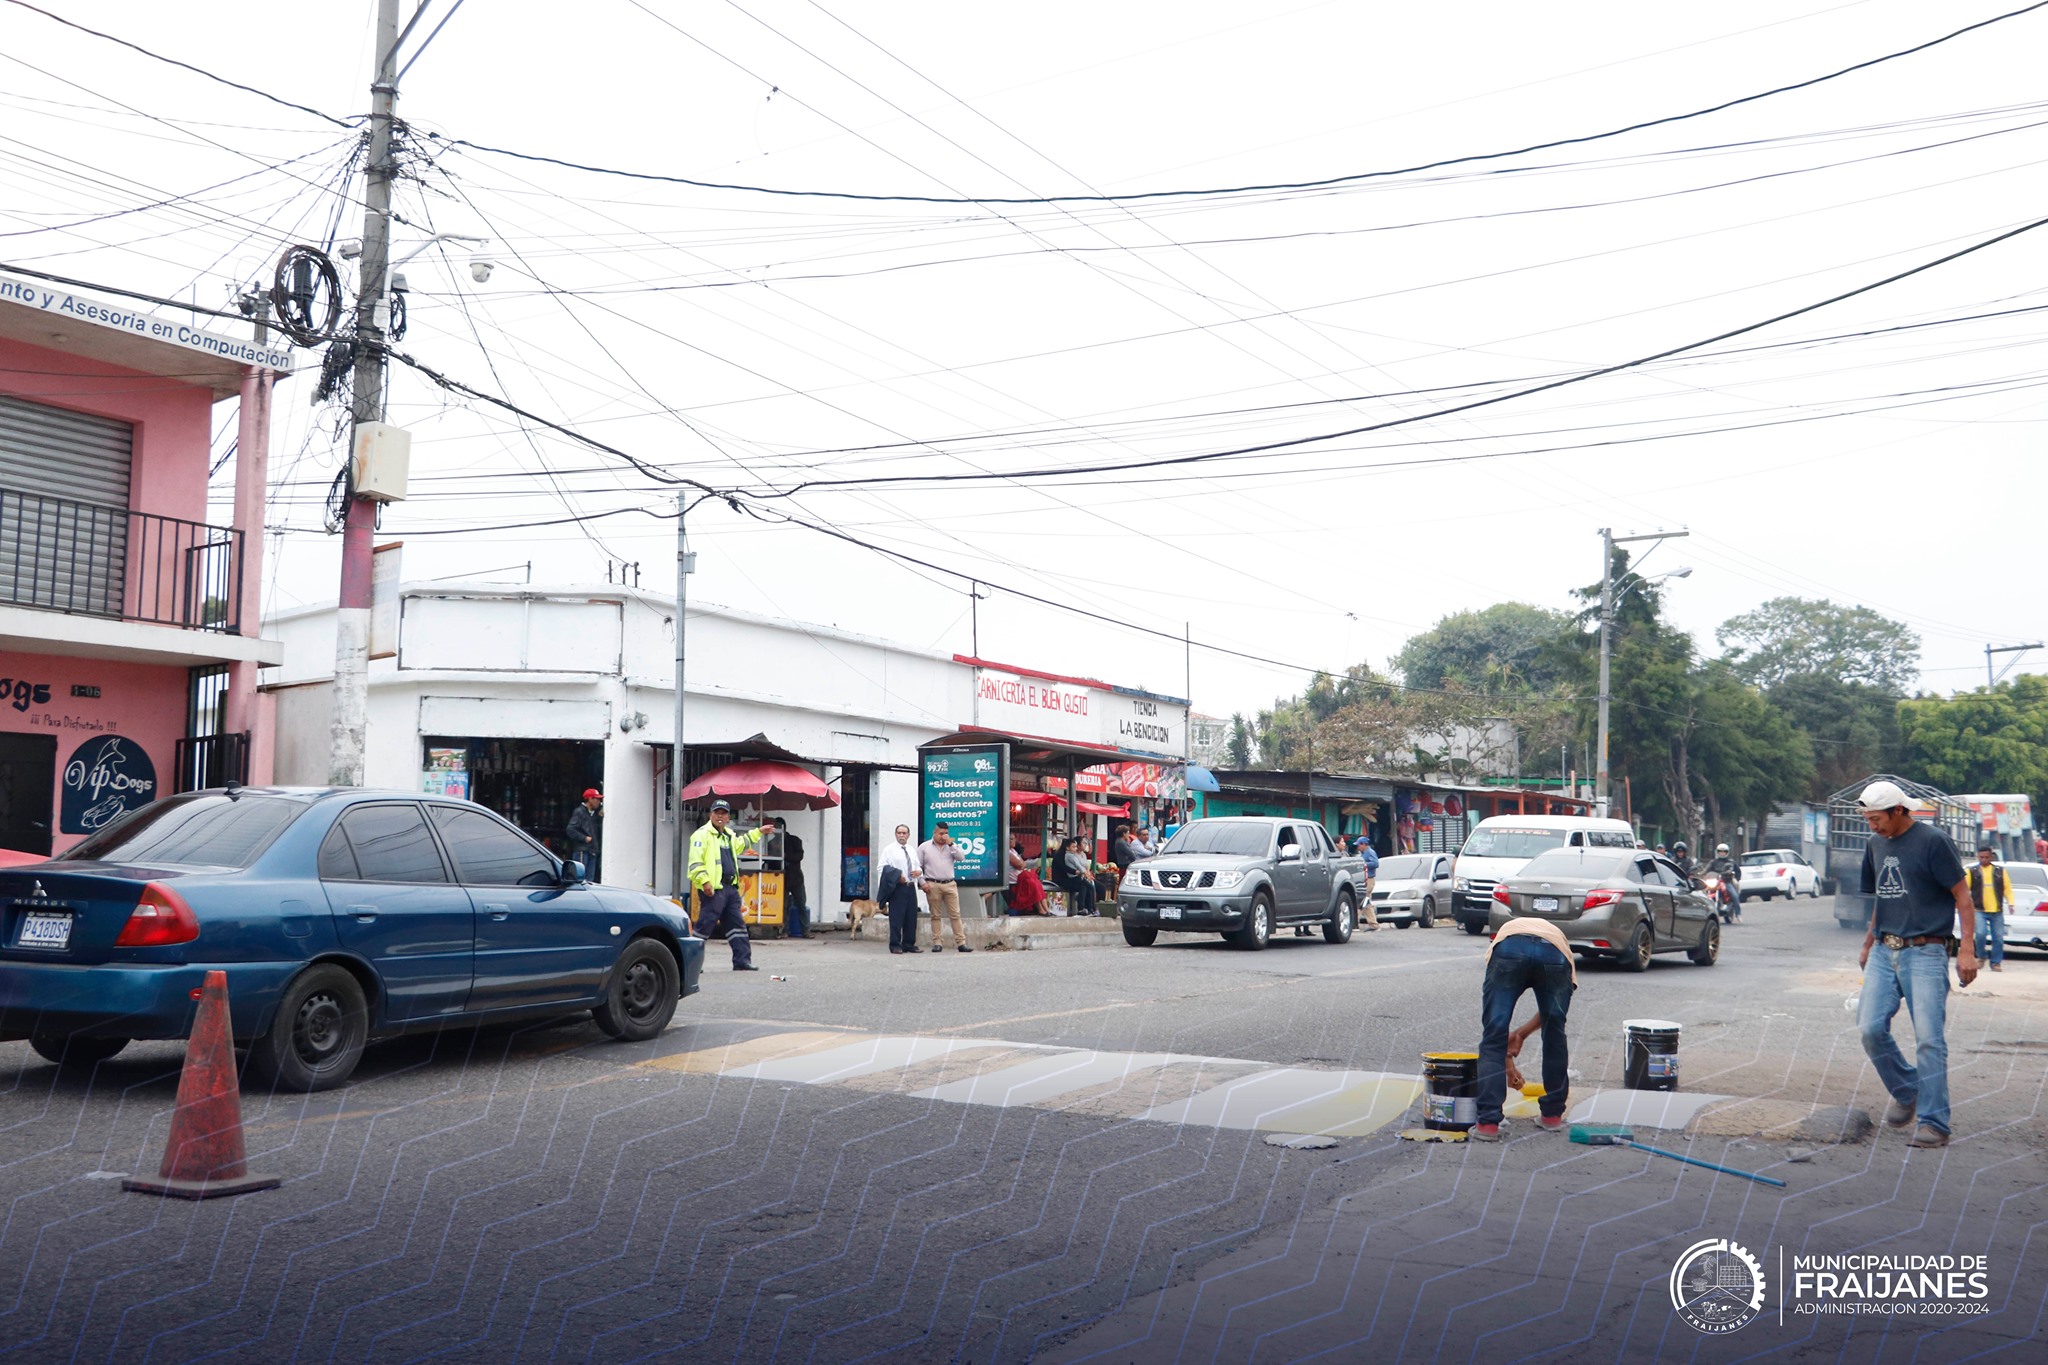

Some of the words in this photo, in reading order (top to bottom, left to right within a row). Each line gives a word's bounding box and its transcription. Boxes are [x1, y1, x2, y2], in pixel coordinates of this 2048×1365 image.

[41, 293, 54, 310] y
[152, 322, 173, 338] en
[178, 327, 290, 368] Computación
[73, 686, 101, 697] 1-06
[1029, 686, 1038, 707] EL
[1042, 688, 1060, 710] BUEN
[1064, 693, 1087, 716] GUSTO
[1133, 700, 1157, 717] TIENDA
[44, 714, 61, 727] Para
[64, 715, 104, 731] Disfrutarlo
[1120, 719, 1133, 736] LA
[1134, 722, 1169, 743] BENDICION
[65, 760, 111, 800] Vip
[110, 773, 153, 794] Dogs
[944, 780, 965, 788] Dios
[979, 780, 995, 788] por
[930, 800, 961, 810] ¿quién
[24, 920, 71, 940] P418DSH
